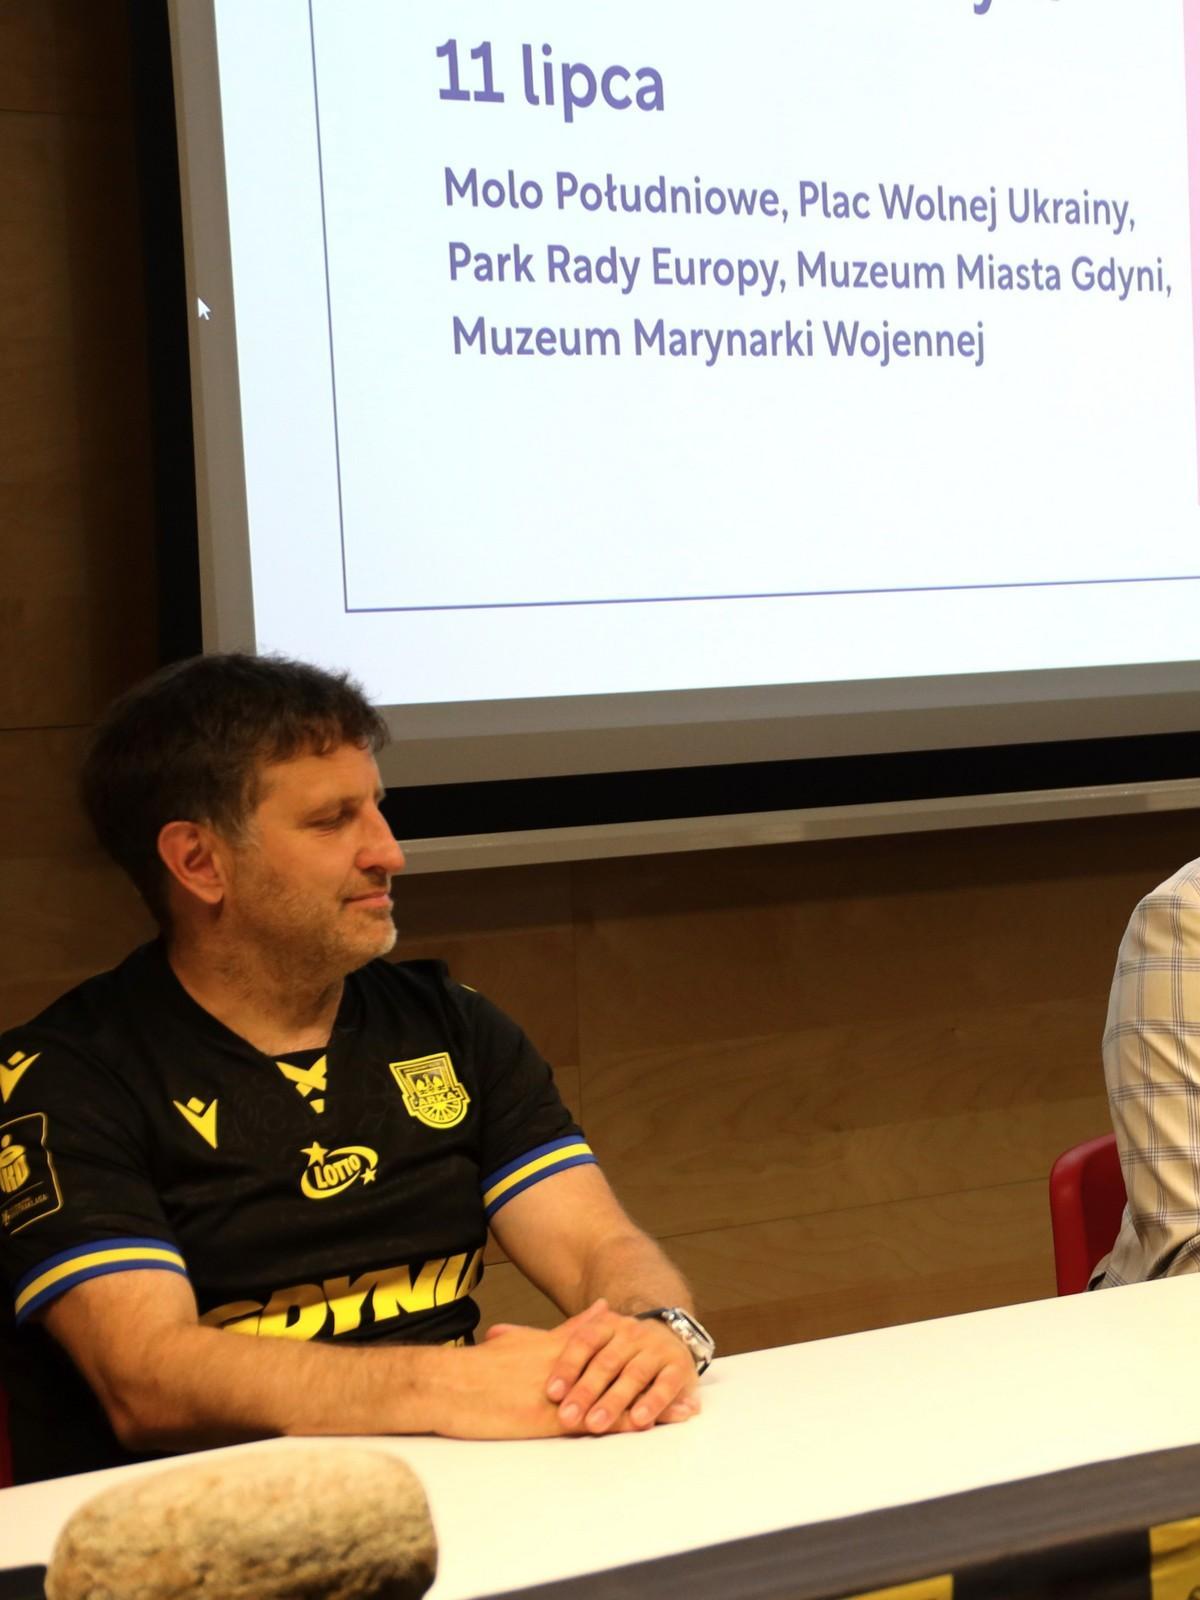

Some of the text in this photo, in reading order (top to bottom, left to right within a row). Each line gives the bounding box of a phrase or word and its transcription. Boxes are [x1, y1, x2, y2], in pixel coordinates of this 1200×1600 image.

[436, 39, 664, 123] 11 lipca
[445, 167, 1134, 235] Molo Południowe, Plac Wolnej Ukrainy,
[449, 242, 1171, 300] Park Rady Europy, Muzeum Miasta Gdyni,
[453, 316, 983, 366] Muzeum Marynarki Wojennej
[313, 1154, 361, 1189] LOTTO
